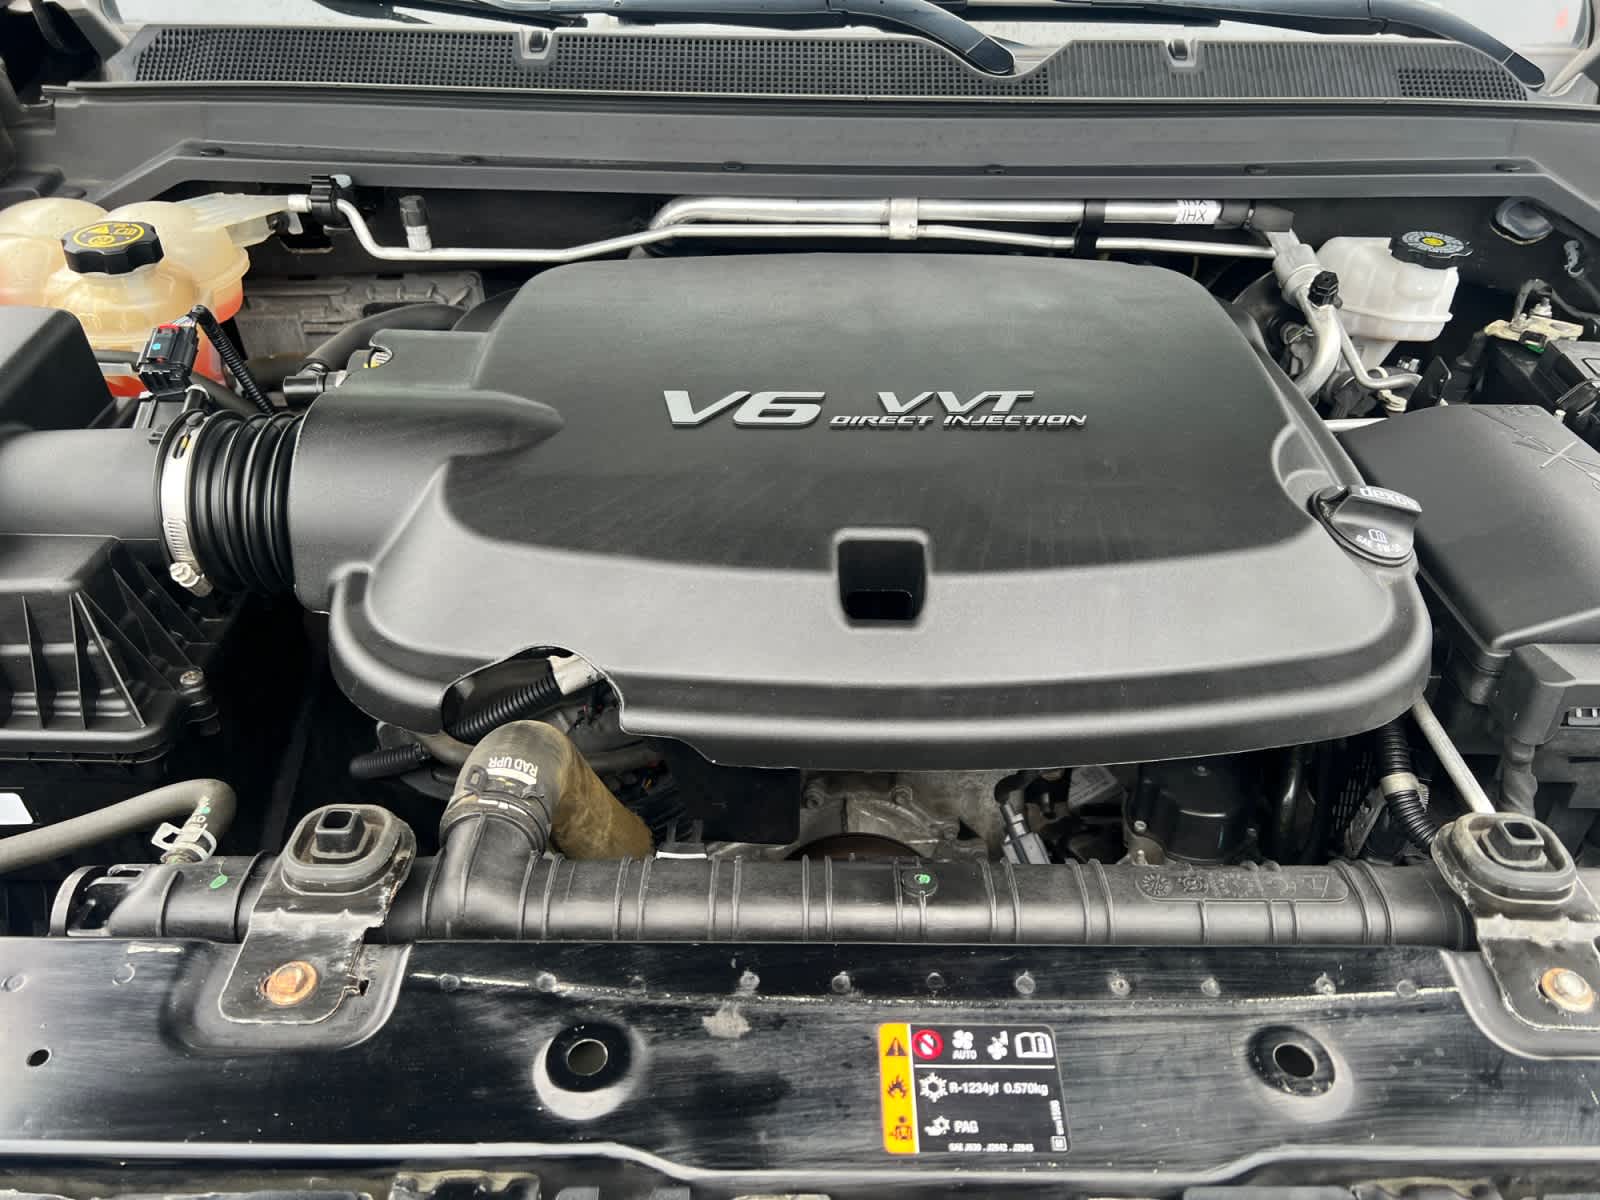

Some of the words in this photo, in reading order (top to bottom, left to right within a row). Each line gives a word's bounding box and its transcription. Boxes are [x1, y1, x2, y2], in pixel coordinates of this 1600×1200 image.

[663, 390, 825, 427] V6
[877, 390, 1035, 415] VVT
[829, 414, 934, 430] DIRECT
[943, 414, 1087, 430] INJECTION
[488, 756, 513, 769] UPR
[515, 757, 539, 778] RAD
[952, 1050, 978, 1060] AUTO
[948, 1081, 1000, 1097] R-1234yf
[1003, 1082, 1049, 1097] 0.570kg
[953, 1120, 979, 1134] PAG
